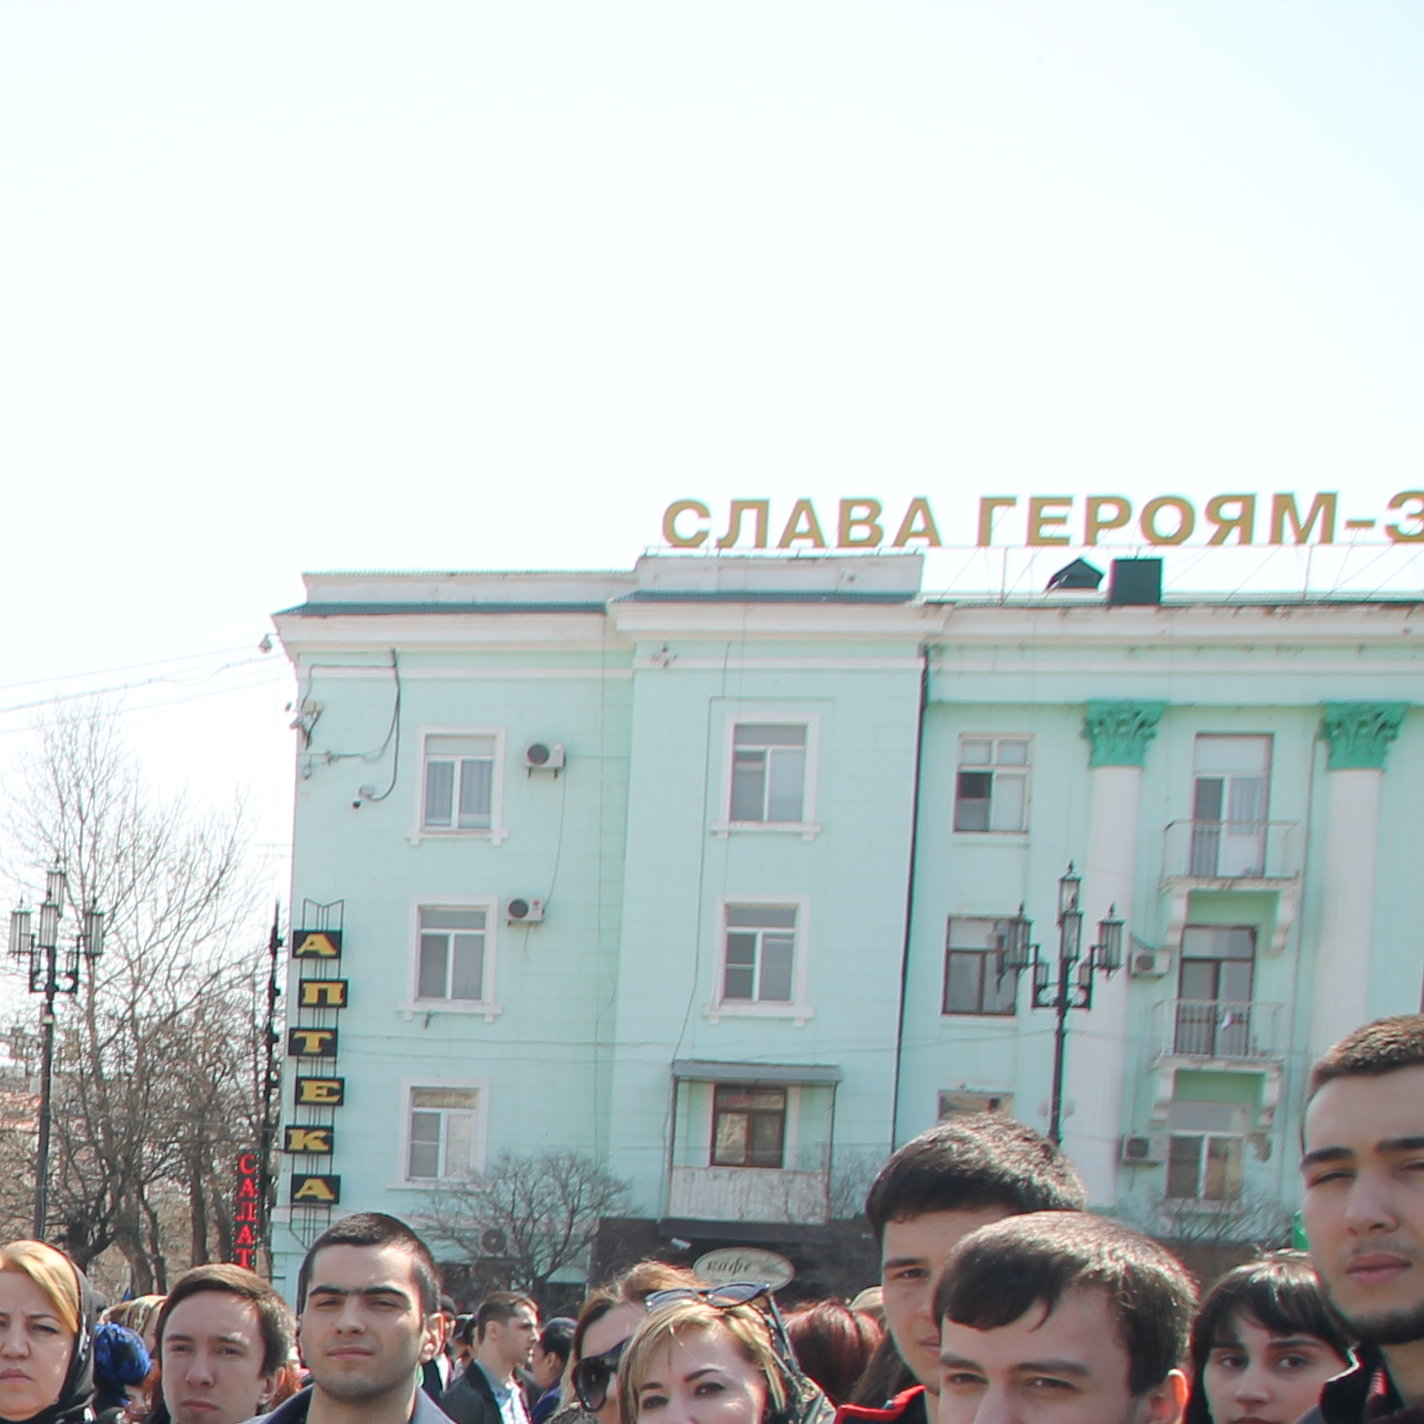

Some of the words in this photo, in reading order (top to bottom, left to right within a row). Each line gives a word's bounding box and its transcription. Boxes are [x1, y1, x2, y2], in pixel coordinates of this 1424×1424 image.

[661, 497, 942, 548] СЛАВА
[287, 933, 345, 1200] АПТЕКА
[234, 1154, 259, 1268] САЛАТ
